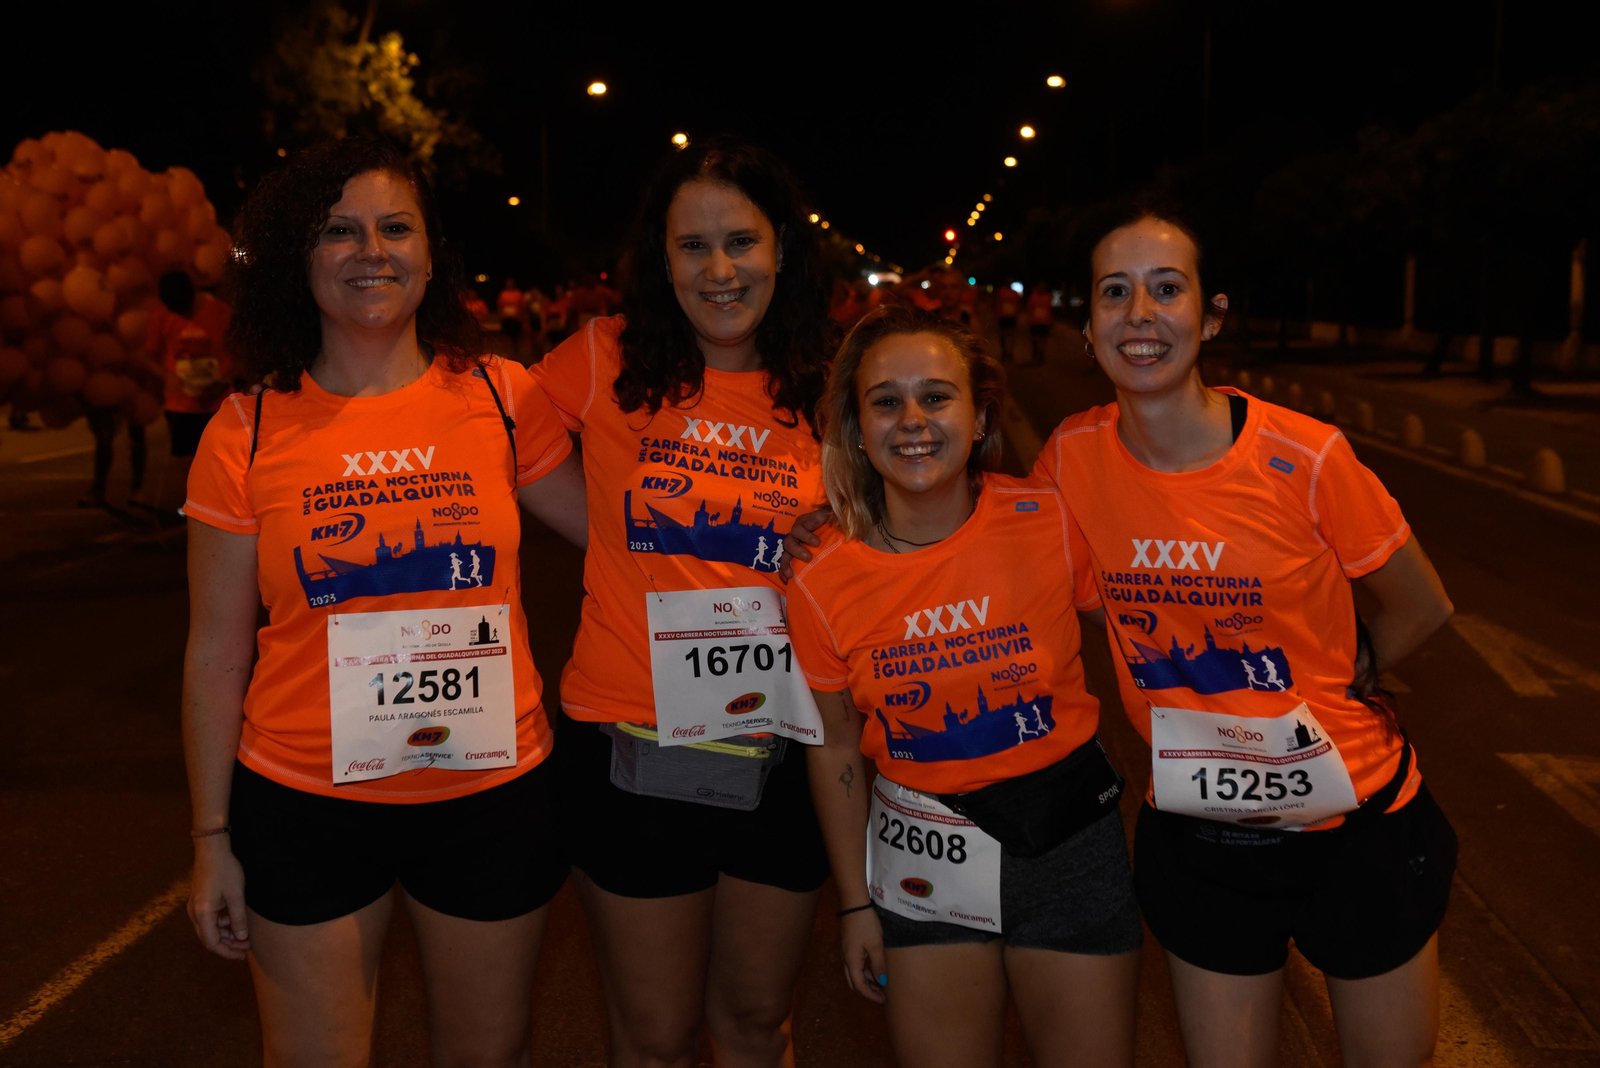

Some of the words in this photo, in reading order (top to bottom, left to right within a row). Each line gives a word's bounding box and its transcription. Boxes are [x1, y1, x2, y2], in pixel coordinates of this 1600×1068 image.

[680, 416, 770, 453] XXXV
[341, 446, 435, 477] XXXV
[638, 448, 648, 462] DEL
[641, 438, 710, 458] CARRERA
[718, 450, 797, 474] NOCTURNA
[650, 452, 798, 488] GUADALQUIVIR
[303, 479, 378, 498] CARRERA
[386, 471, 472, 487] NOCTURNA
[314, 484, 476, 512] GUADALQUIVIR
[630, 541, 654, 550] 2023
[1130, 539, 1225, 571] XXXV
[1102, 570, 1164, 586] CARRERA
[1171, 575, 1262, 588] NOCTURNA
[310, 594, 336, 606] 2023
[1110, 588, 1263, 606] GUADALQUIVIR
[904, 596, 990, 640] XXXV
[704, 630, 736, 638] NOCTURNA
[872, 641, 938, 660] CARRERA
[944, 622, 1029, 650] NOCTURNA
[438, 650, 480, 659] GUADALQUIVIR
[685, 642, 792, 678] 16701
[882, 637, 1032, 678] GUADALQUIVIR
[368, 666, 478, 706] 12581
[369, 714, 395, 722] PAULA
[398, 709, 441, 720] ARAGONÉS
[444, 706, 484, 716] ESCAMILLA
[780, 720, 816, 736] Cruzcampo
[465, 750, 507, 760] Cruzcampo
[892, 750, 914, 760] 2023
[1212, 752, 1245, 760] NOCTURNA
[1257, 754, 1302, 764] GUADALQUIVIR
[1192, 767, 1313, 801] 15253
[890, 802, 913, 815] NOCTURNA
[923, 813, 964, 825] GUADALQUIVIR
[1245, 806, 1278, 814] GARCÍA
[878, 812, 967, 864] 22608
[949, 910, 993, 924] Cruzcampo
